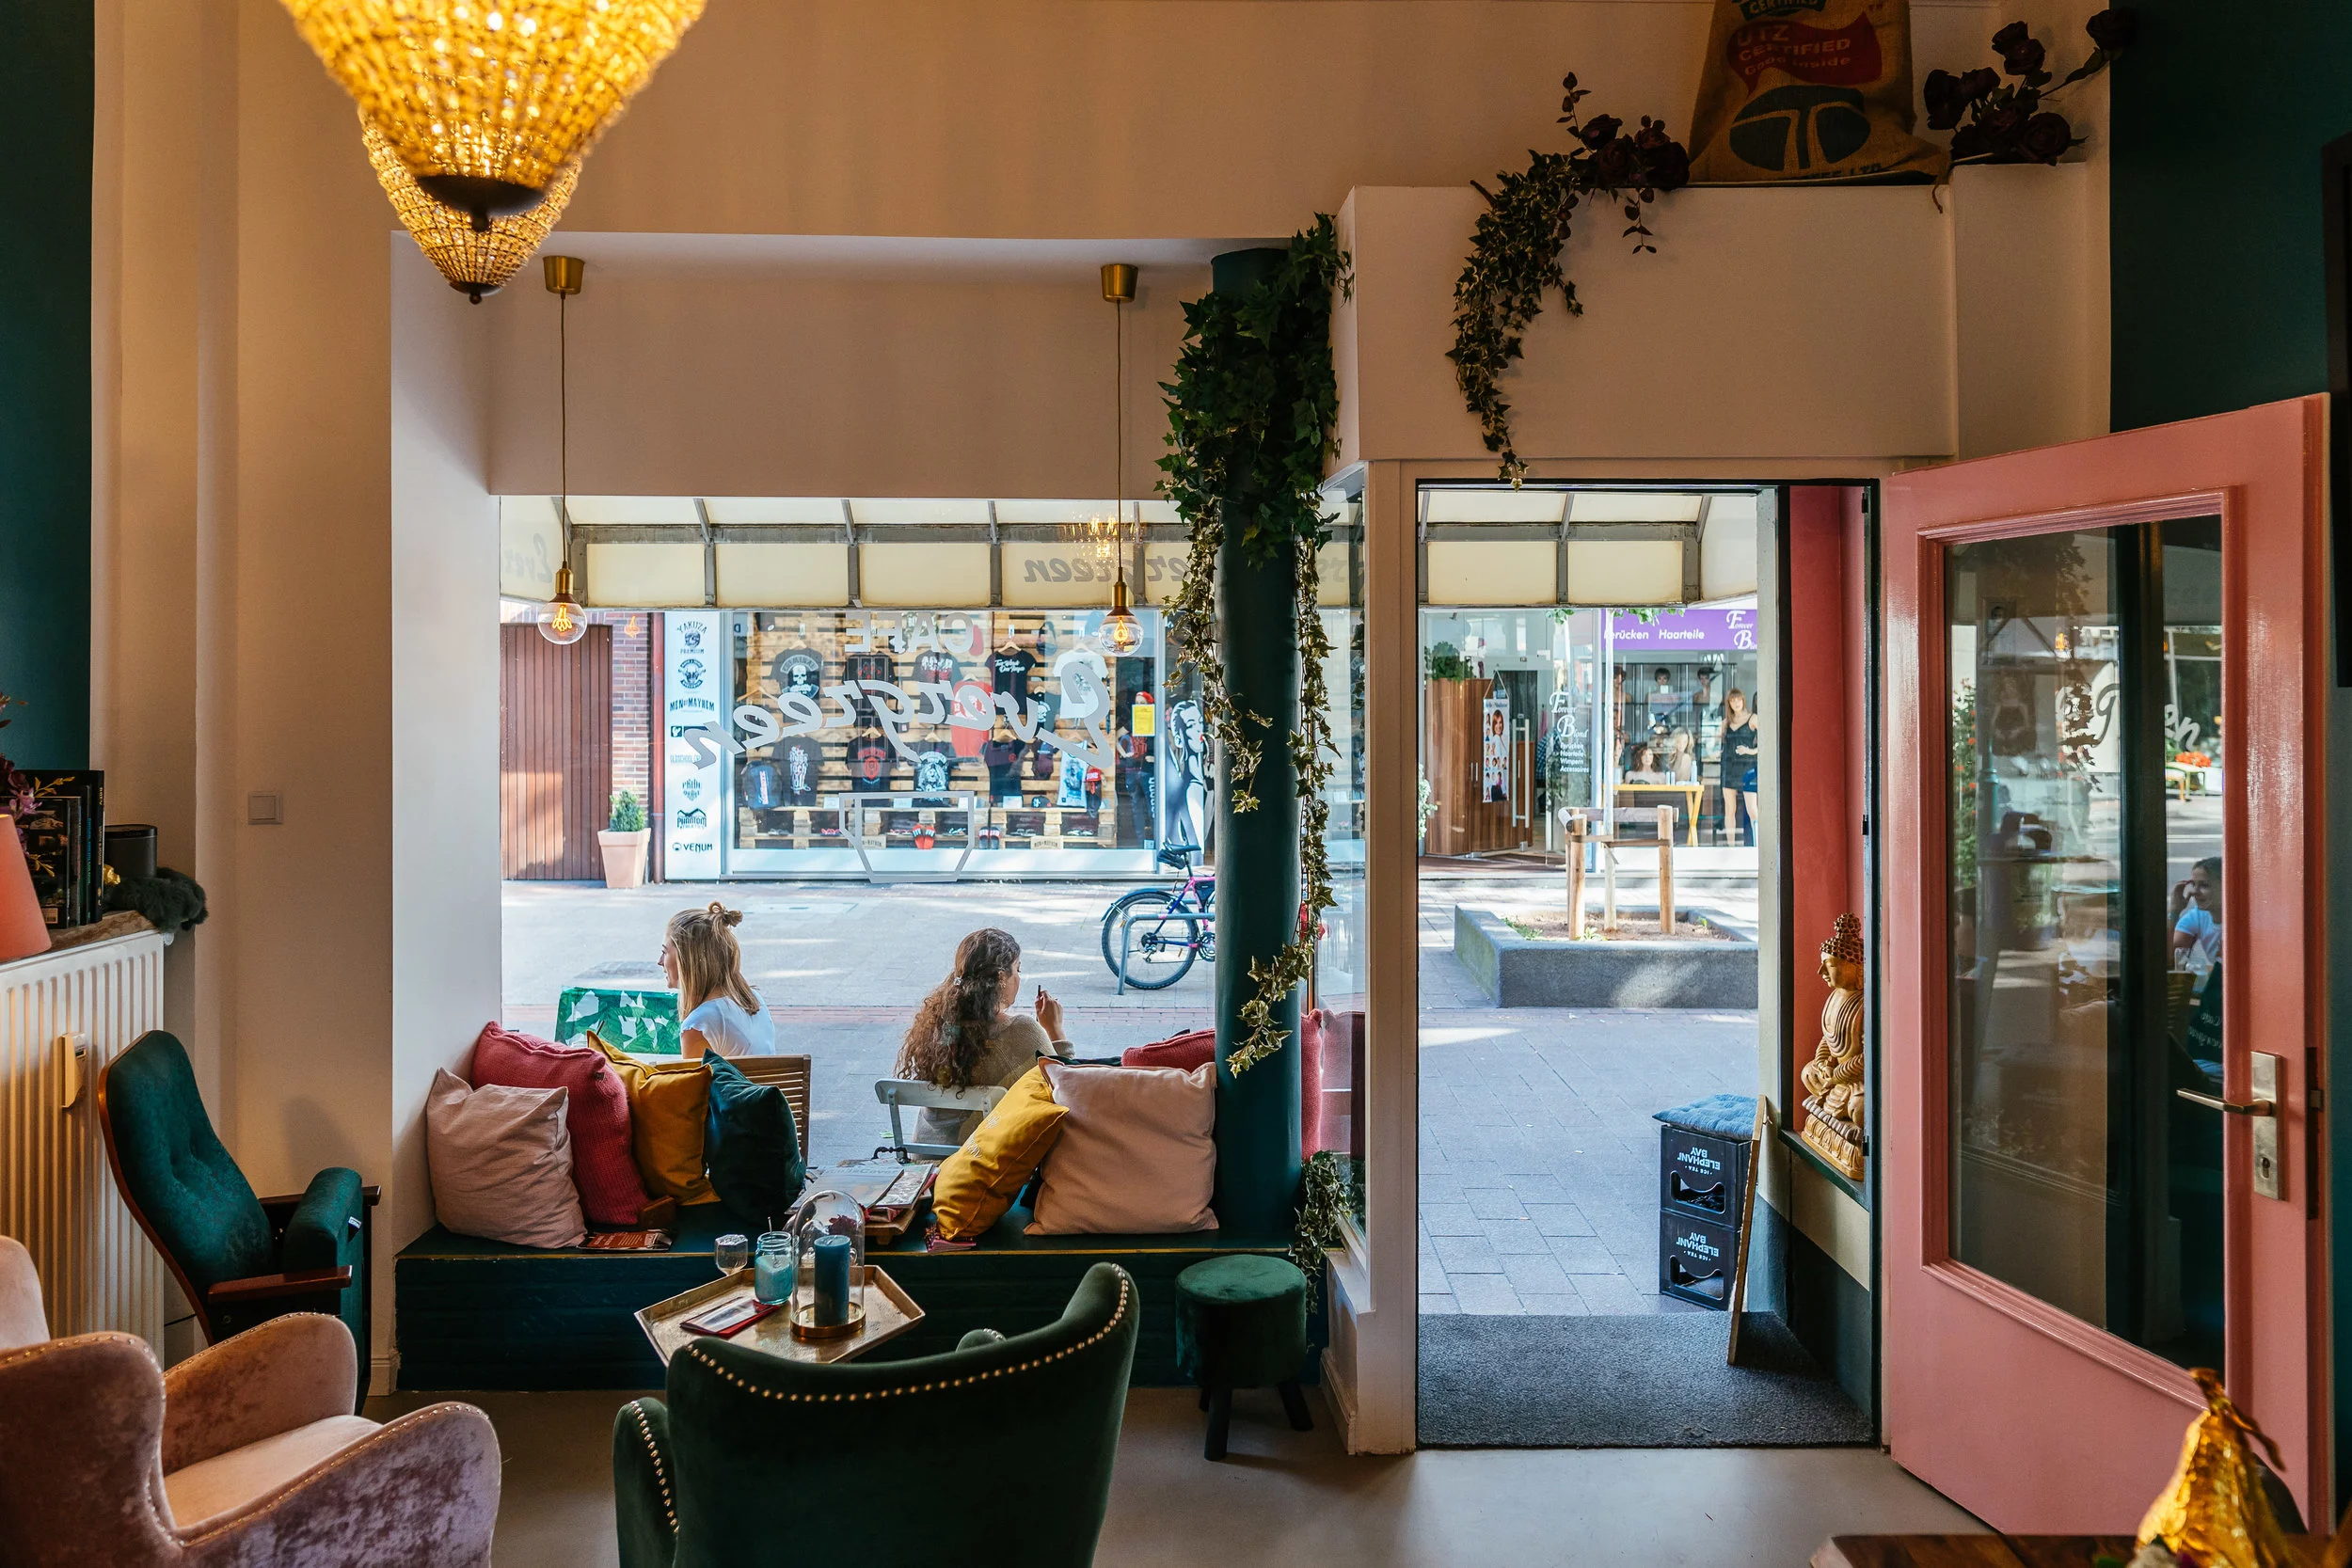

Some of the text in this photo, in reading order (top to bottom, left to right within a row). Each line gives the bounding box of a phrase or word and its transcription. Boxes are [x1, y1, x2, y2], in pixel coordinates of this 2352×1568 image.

[1739, 39, 1851, 61] CERTIFIED
[676, 621, 707, 634] YAKUZA
[1726, 610, 1754, 629] Forever
[1604, 628, 1705, 641] erücken Haarteile
[670, 699, 683, 712] MEN
[688, 697, 715, 712] MAYHEM
[1549, 691, 1577, 713] Forever
[1557, 715, 1589, 738] Blond
[683, 843, 713, 853] VENUM
[1690, 1147, 1708, 1158] BAY
[1677, 1152, 1721, 1171] ELEPHANT
[1689, 1232, 1707, 1244] BAY
[1676, 1236, 1720, 1258] ELEPHANT
